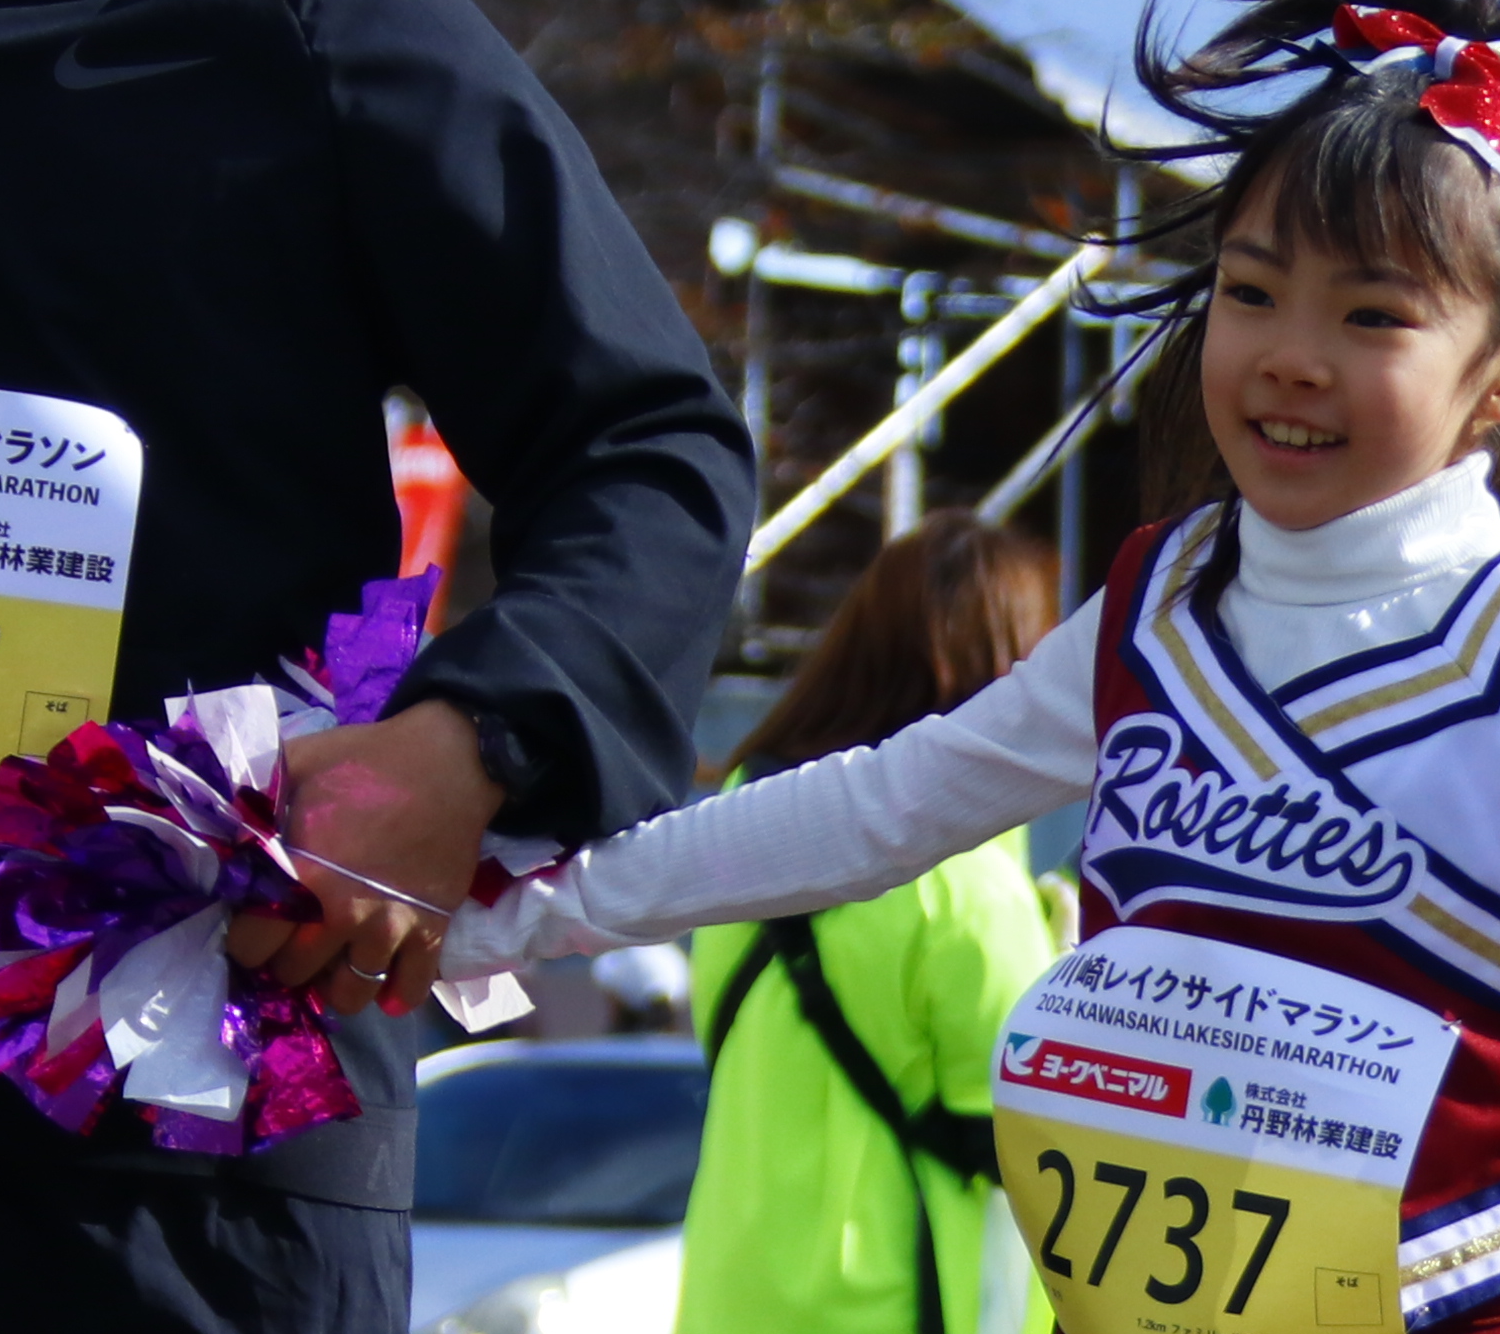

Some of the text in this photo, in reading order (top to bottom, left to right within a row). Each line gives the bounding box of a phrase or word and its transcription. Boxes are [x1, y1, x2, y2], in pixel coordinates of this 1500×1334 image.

[1091, 723, 1412, 887] Rosettes
[1035, 993, 1400, 1085] 2024 KAWASAKI LAKESIDE MARATHON
[1050, 953, 1414, 1053] 川崎レイクサイドマラソン
[1039, 1052, 1169, 1104] ヨークベニマル
[1245, 1082, 1306, 1108] 株式会社
[1240, 1103, 1401, 1160] 丹野林業建設
[1037, 1148, 1290, 1315] 2737
[1136, 1317, 1166, 1333] 1.2km
